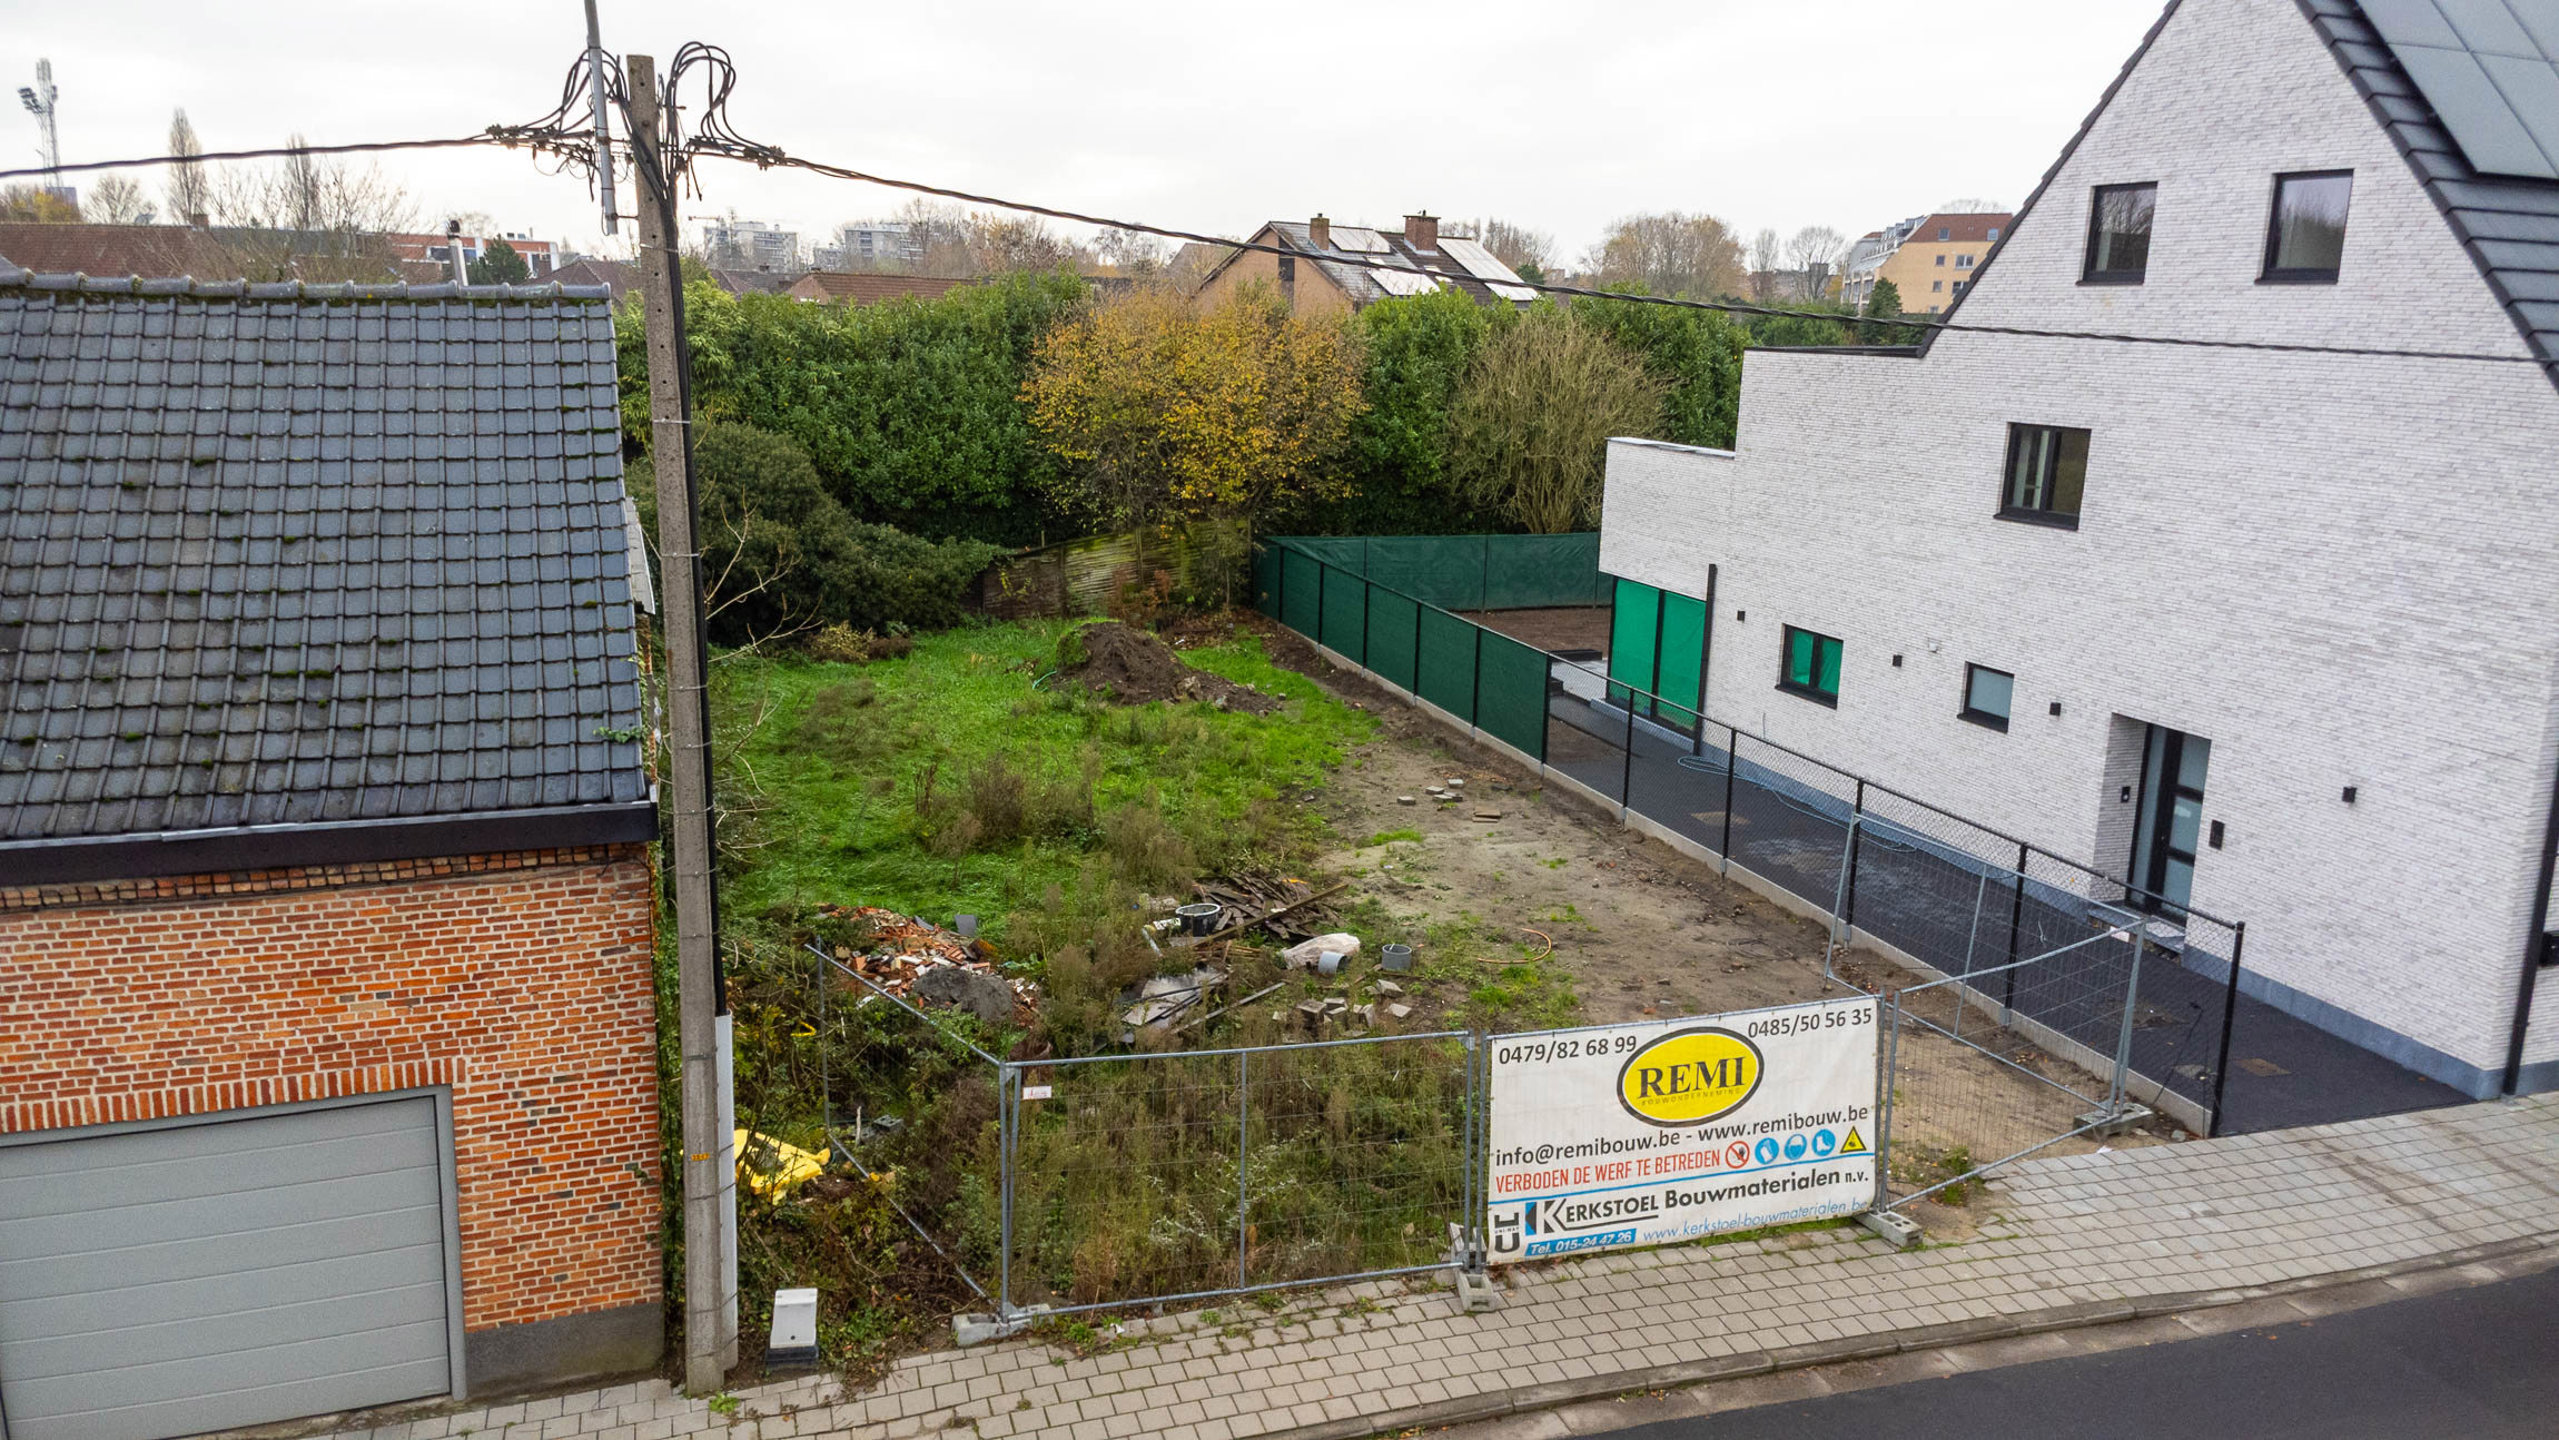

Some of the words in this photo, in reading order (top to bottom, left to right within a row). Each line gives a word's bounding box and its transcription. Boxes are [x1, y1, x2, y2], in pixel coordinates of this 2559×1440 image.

[1748, 1014, 1820, 1038] 0485/50
[1825, 1011, 1846, 1028] 56
[1851, 1008, 1872, 1026] 35
[1499, 1040, 1579, 1065] 0479/82
[1586, 1038, 1609, 1056] 68
[1615, 1035, 1637, 1053] 99
[1637, 1056, 1746, 1099] REMI
[1496, 1129, 1680, 1166] info@remibouw.be
[1698, 1105, 1868, 1142] www.remibouw.be
[1496, 1168, 1569, 1194] VERBODEN
[1573, 1166, 1590, 1185] DE
[1595, 1161, 1632, 1181] WERF
[1636, 1158, 1651, 1176] TE
[1655, 1149, 1721, 1174] BETREDEN
[1665, 1168, 1840, 1209] Bouwmaterialen
[1845, 1170, 1869, 1183] n.v.
[1642, 1200, 1868, 1241] www.kerkstoel-bouwmaterialen.be
[1530, 1243, 1551, 1255] Tel.
[1555, 1238, 1596, 1252] 015-24
[1600, 1234, 1614, 1246] 47
[1617, 1231, 1632, 1244] 26
